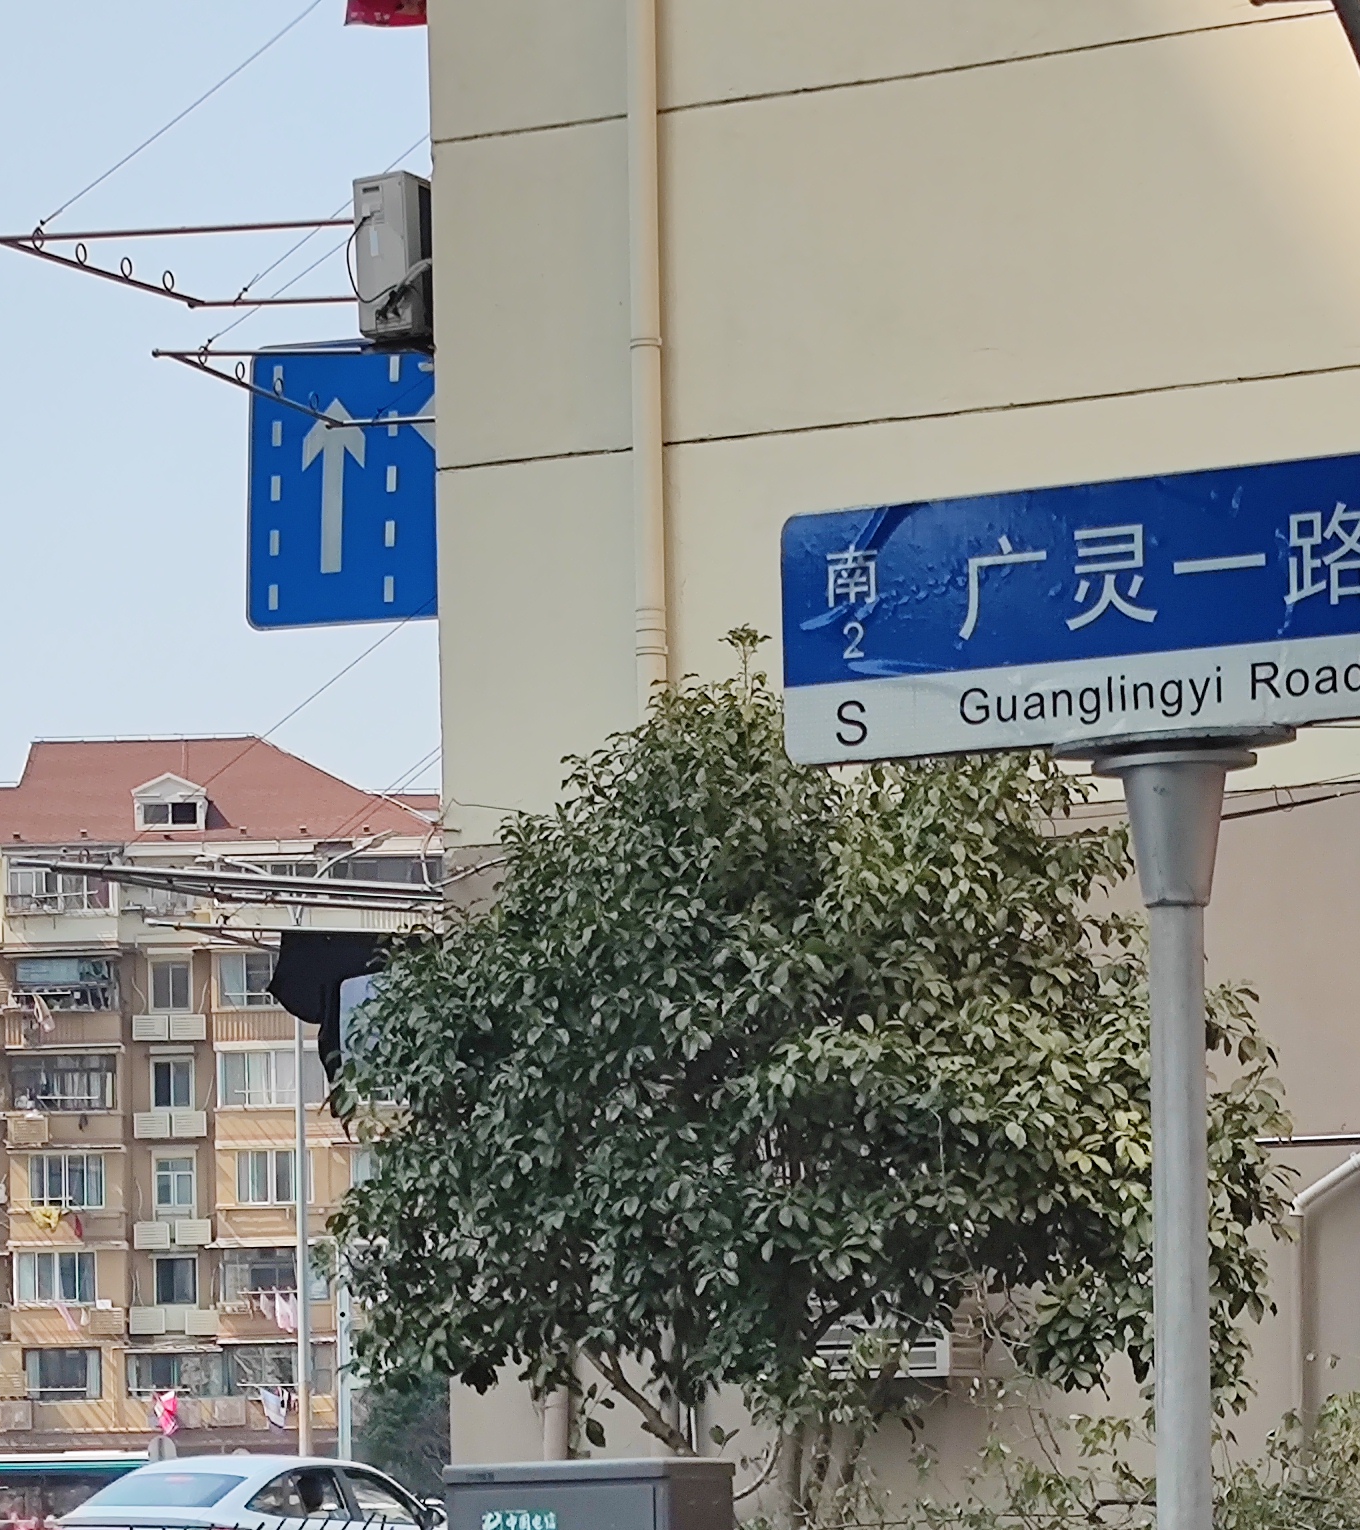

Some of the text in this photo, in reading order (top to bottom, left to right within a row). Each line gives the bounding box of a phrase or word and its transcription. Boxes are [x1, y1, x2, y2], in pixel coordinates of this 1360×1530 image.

[826, 544, 878, 609] 南
[842, 620, 866, 662] 2
[834, 699, 870, 748] S
[958, 664, 1225, 729] Guanglingyi
